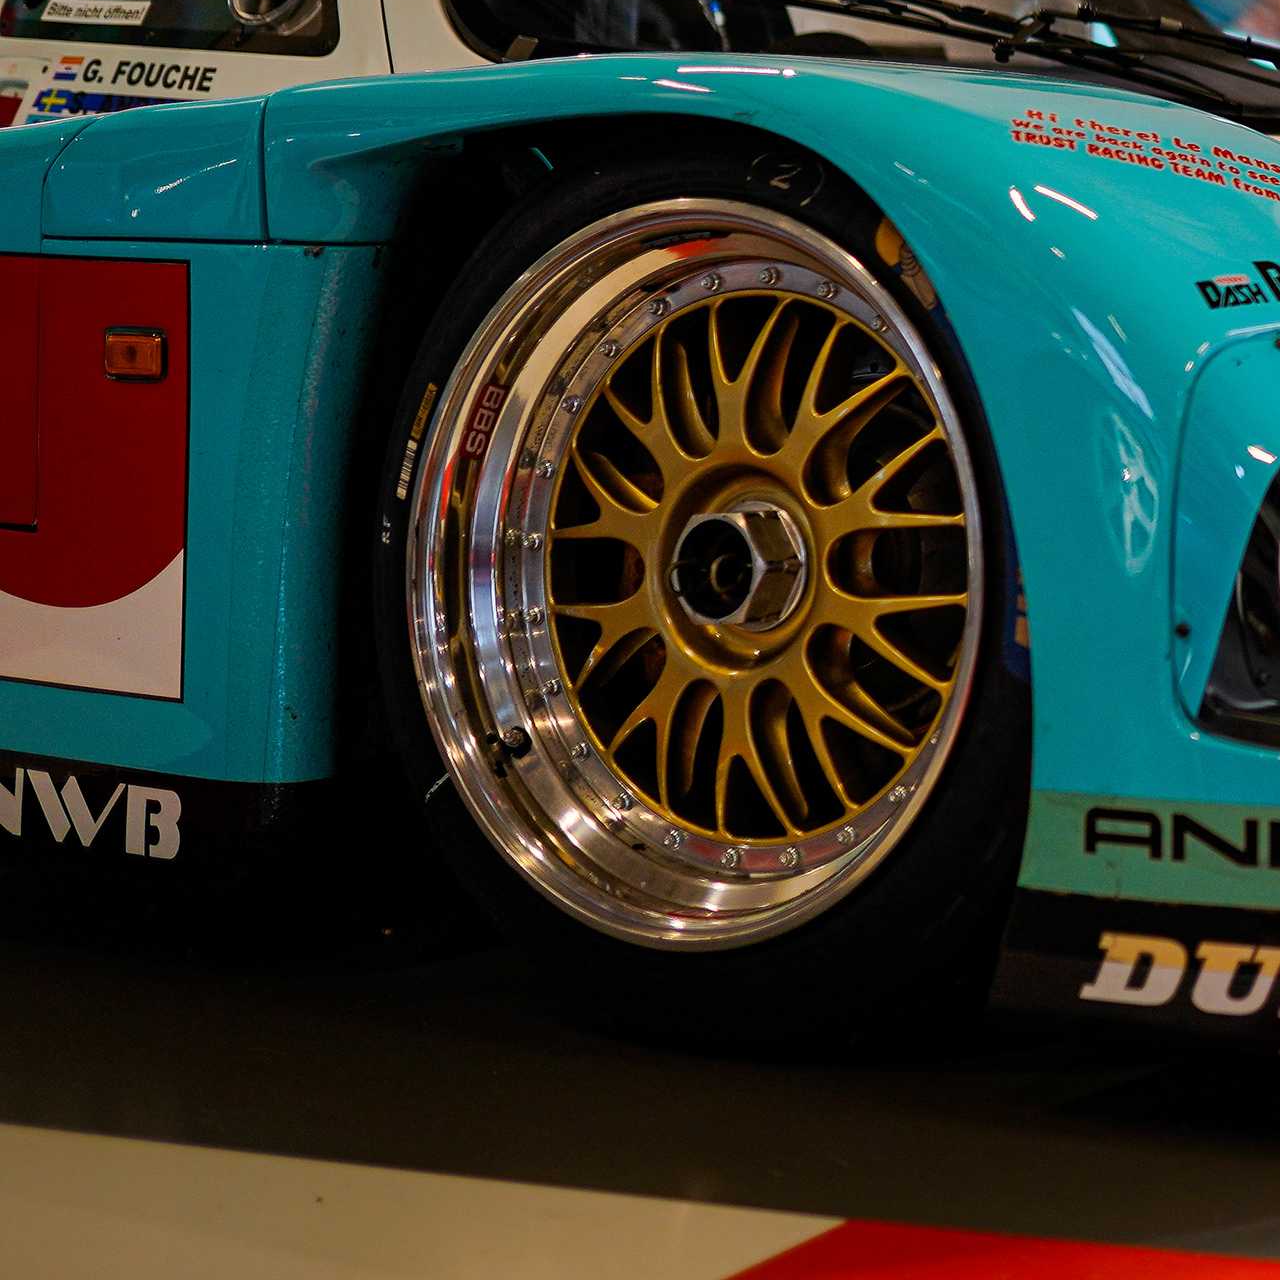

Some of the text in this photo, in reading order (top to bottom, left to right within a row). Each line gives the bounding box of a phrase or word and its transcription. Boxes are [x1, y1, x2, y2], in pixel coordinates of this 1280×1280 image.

[82, 58, 217, 93] G. FOUCHE
[1011, 131, 1077, 151] TRUST
[1086, 143, 1165, 170] RACING
[1170, 162, 1227, 186] TEAM
[1026, 109, 1058, 124] Hi
[1074, 118, 1160, 144] there!
[1174, 137, 1201, 153] Le
[1051, 127, 1087, 140] are
[1094, 134, 1145, 152] back
[1151, 147, 1213, 168] again
[1217, 161, 1241, 175] to
[1247, 170, 1280, 186] see
[465, 385, 505, 455] BBS
